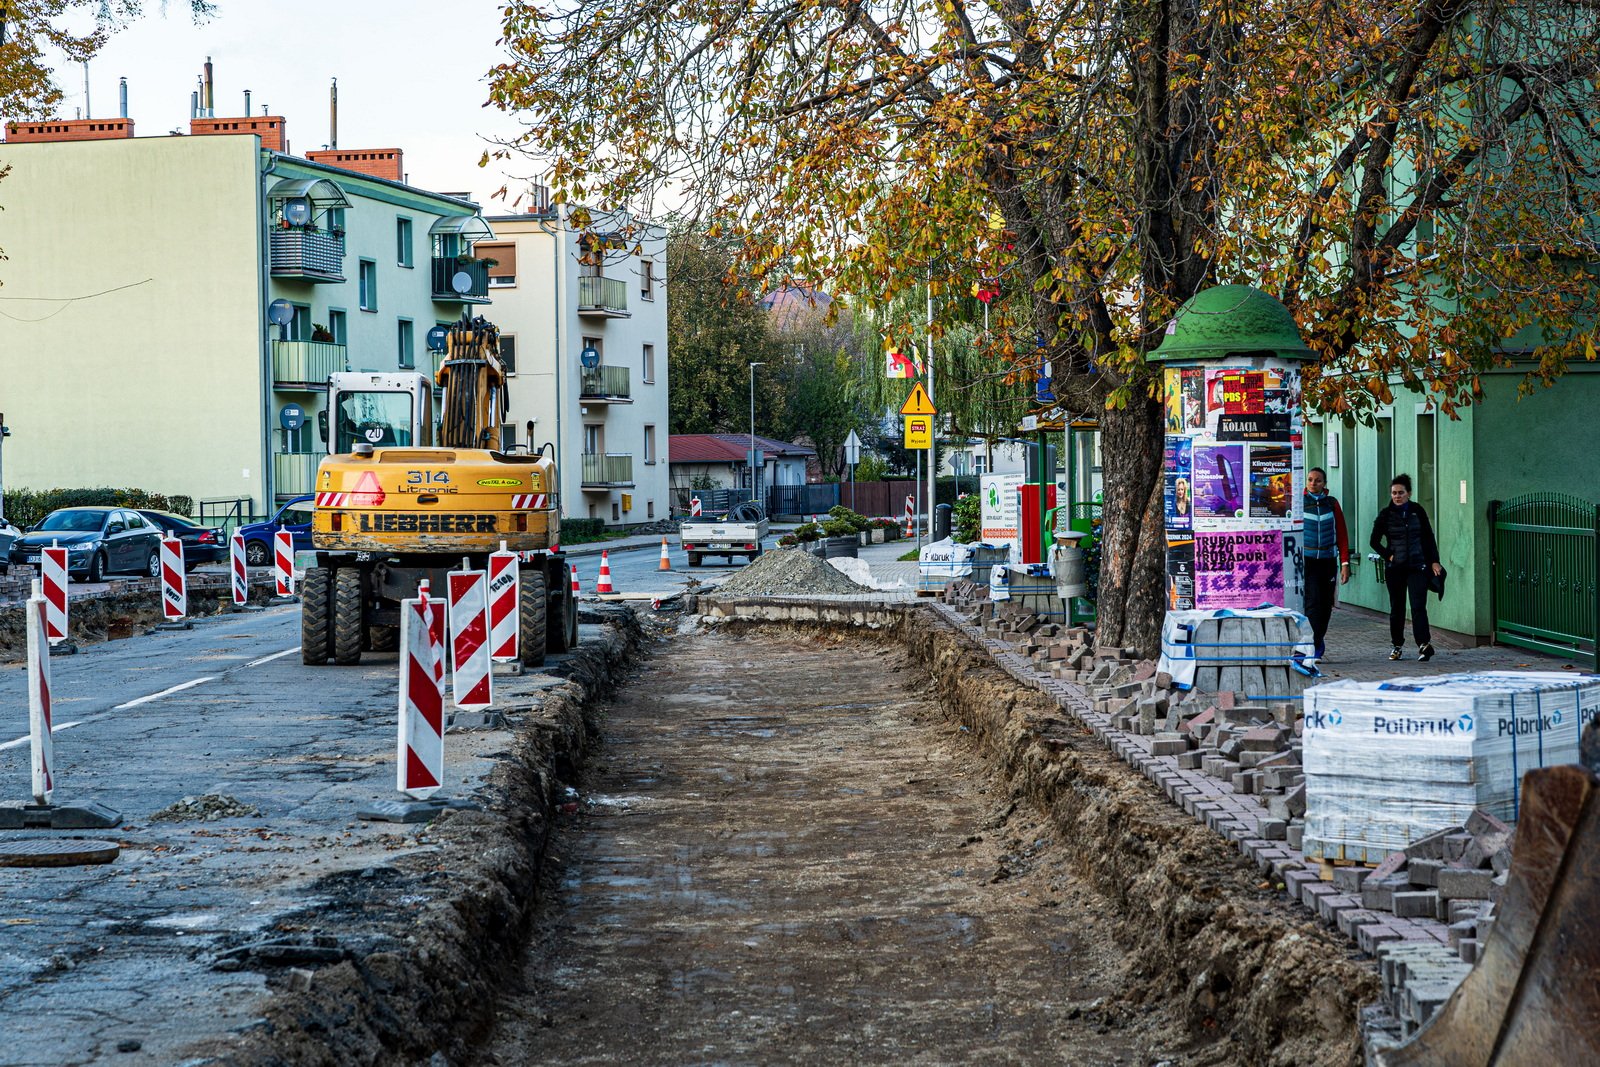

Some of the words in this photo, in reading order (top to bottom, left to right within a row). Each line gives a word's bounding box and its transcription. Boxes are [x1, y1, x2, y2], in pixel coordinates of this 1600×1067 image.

[1222, 421, 1258, 432] KOLACJA
[407, 470, 450, 484] 314
[398, 485, 458, 494] Litronic
[360, 514, 498, 533] LIEBHERR
[1195, 534, 1276, 545] TRUBADURZY
[1197, 544, 1234, 554] JAZZU
[1196, 561, 1235, 571] JAZZU
[1374, 716, 1456, 736] Polbruk
[1498, 715, 1552, 737] Polbruk
